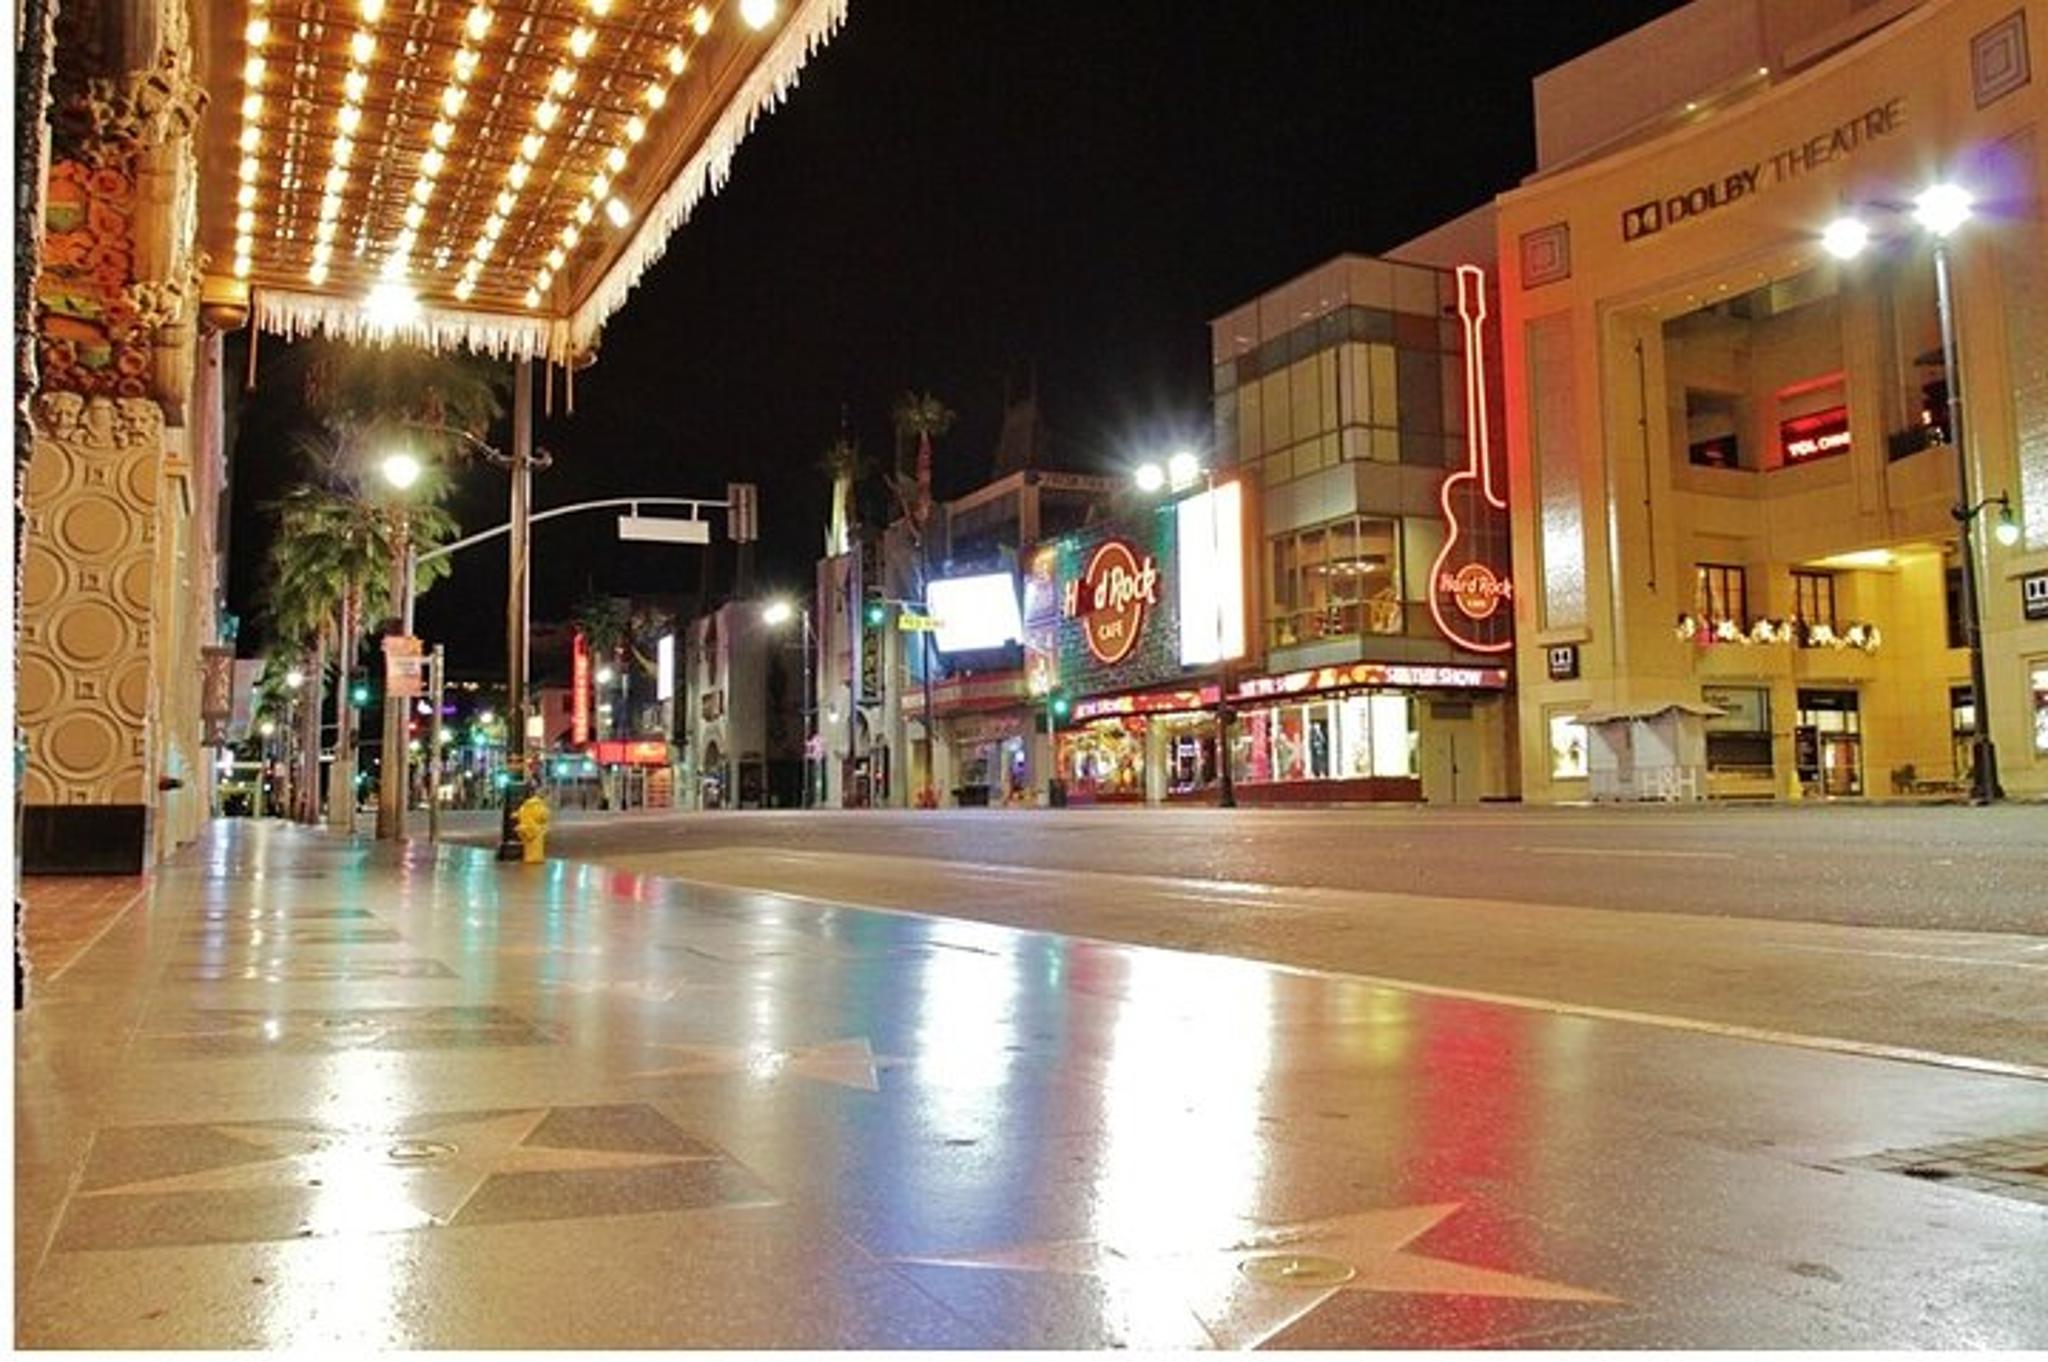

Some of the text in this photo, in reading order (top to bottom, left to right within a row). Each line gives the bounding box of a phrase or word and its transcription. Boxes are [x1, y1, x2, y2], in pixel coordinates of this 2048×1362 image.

[1666, 97, 1908, 225] DOLBY THEATRE
[1108, 556, 1156, 612] Rock
[1478, 575, 1512, 600] Rock
